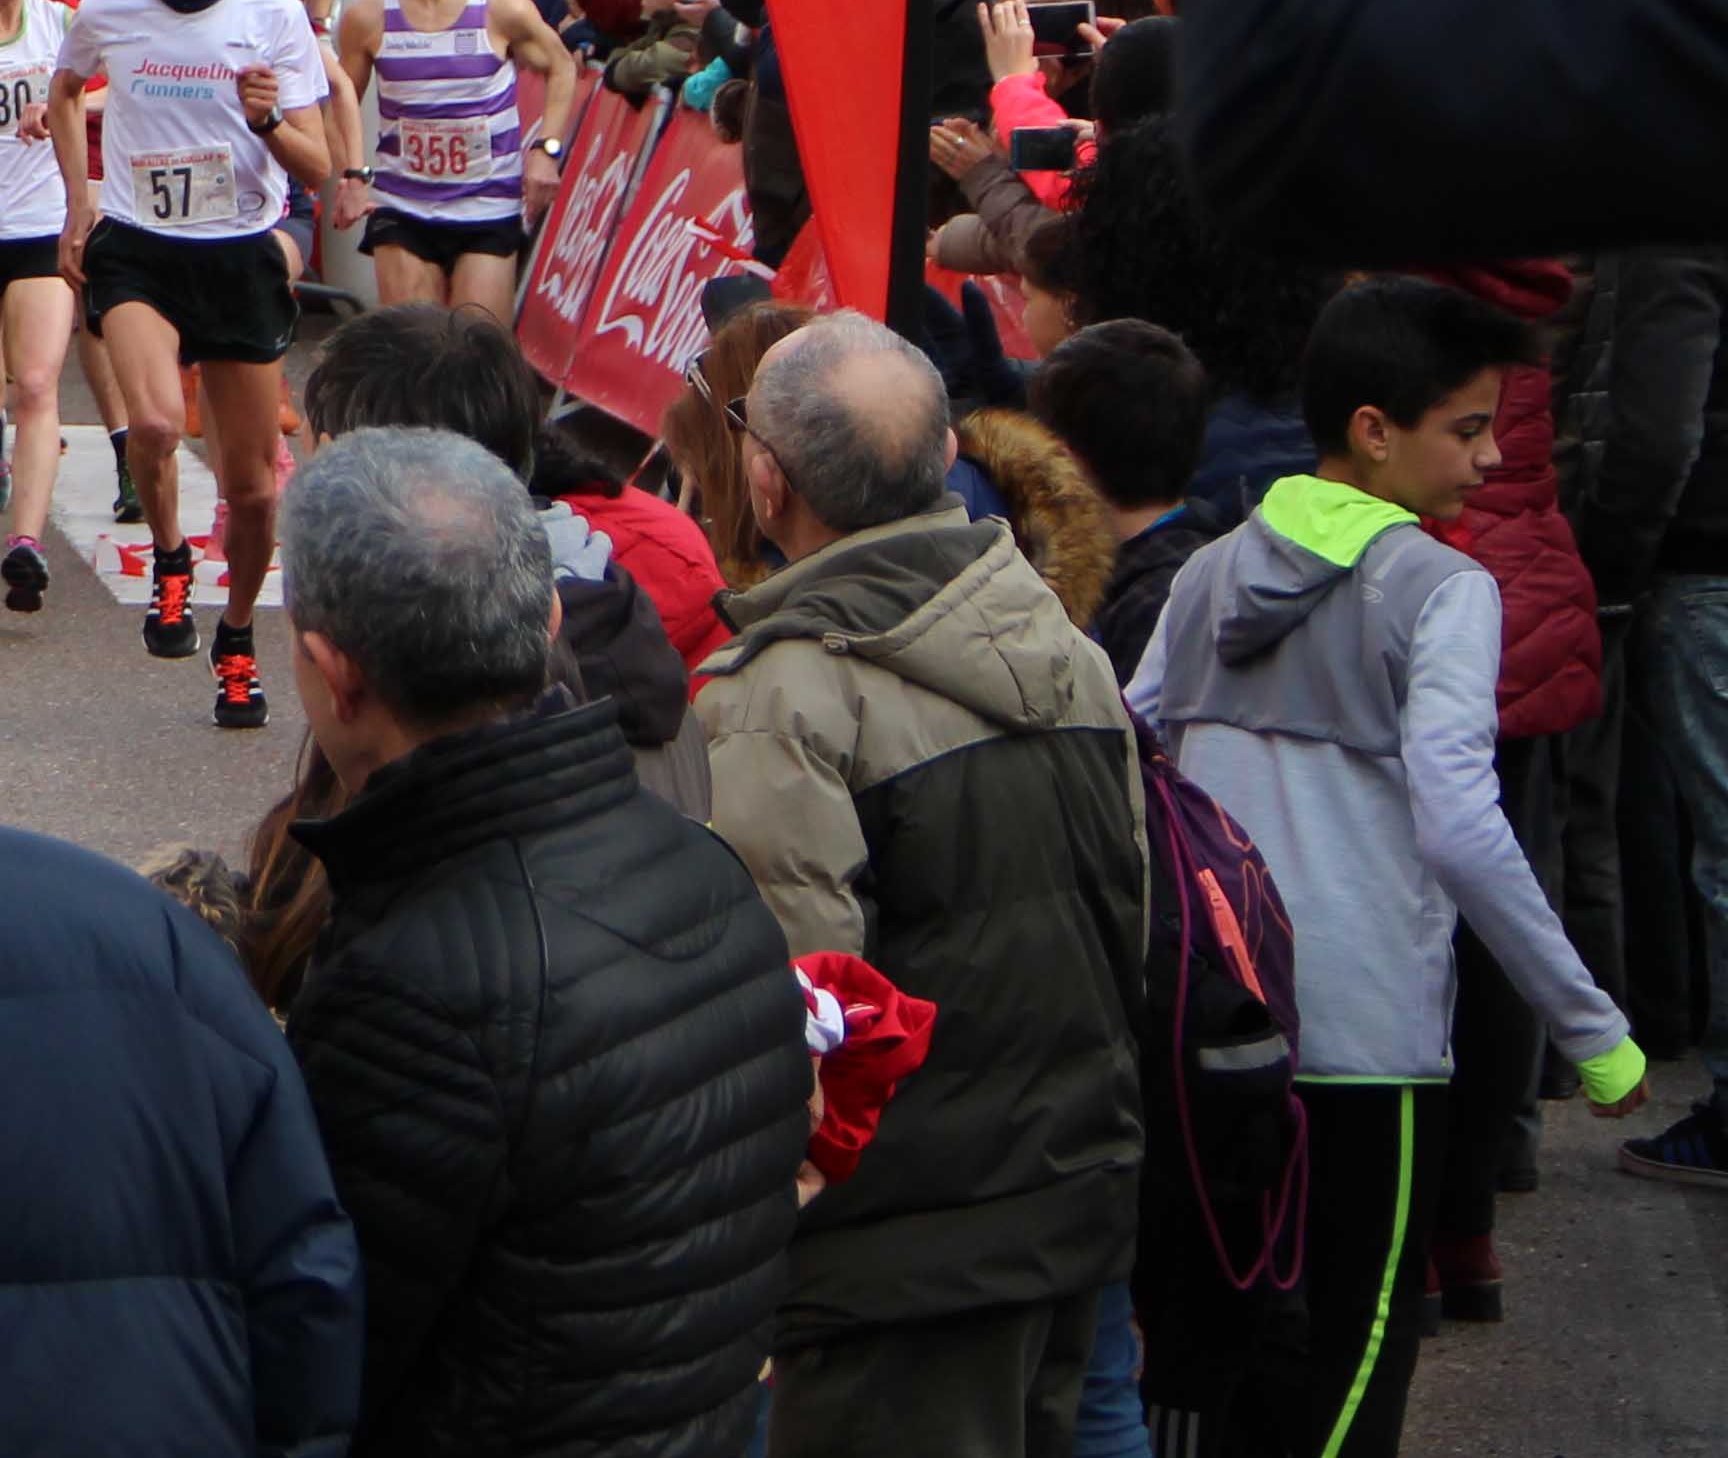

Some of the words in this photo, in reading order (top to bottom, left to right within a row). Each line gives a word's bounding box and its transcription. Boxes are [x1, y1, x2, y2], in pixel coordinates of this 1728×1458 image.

[131, 58, 234, 82] Jacquelin
[407, 135, 468, 176] 356
[150, 168, 192, 219] 57
